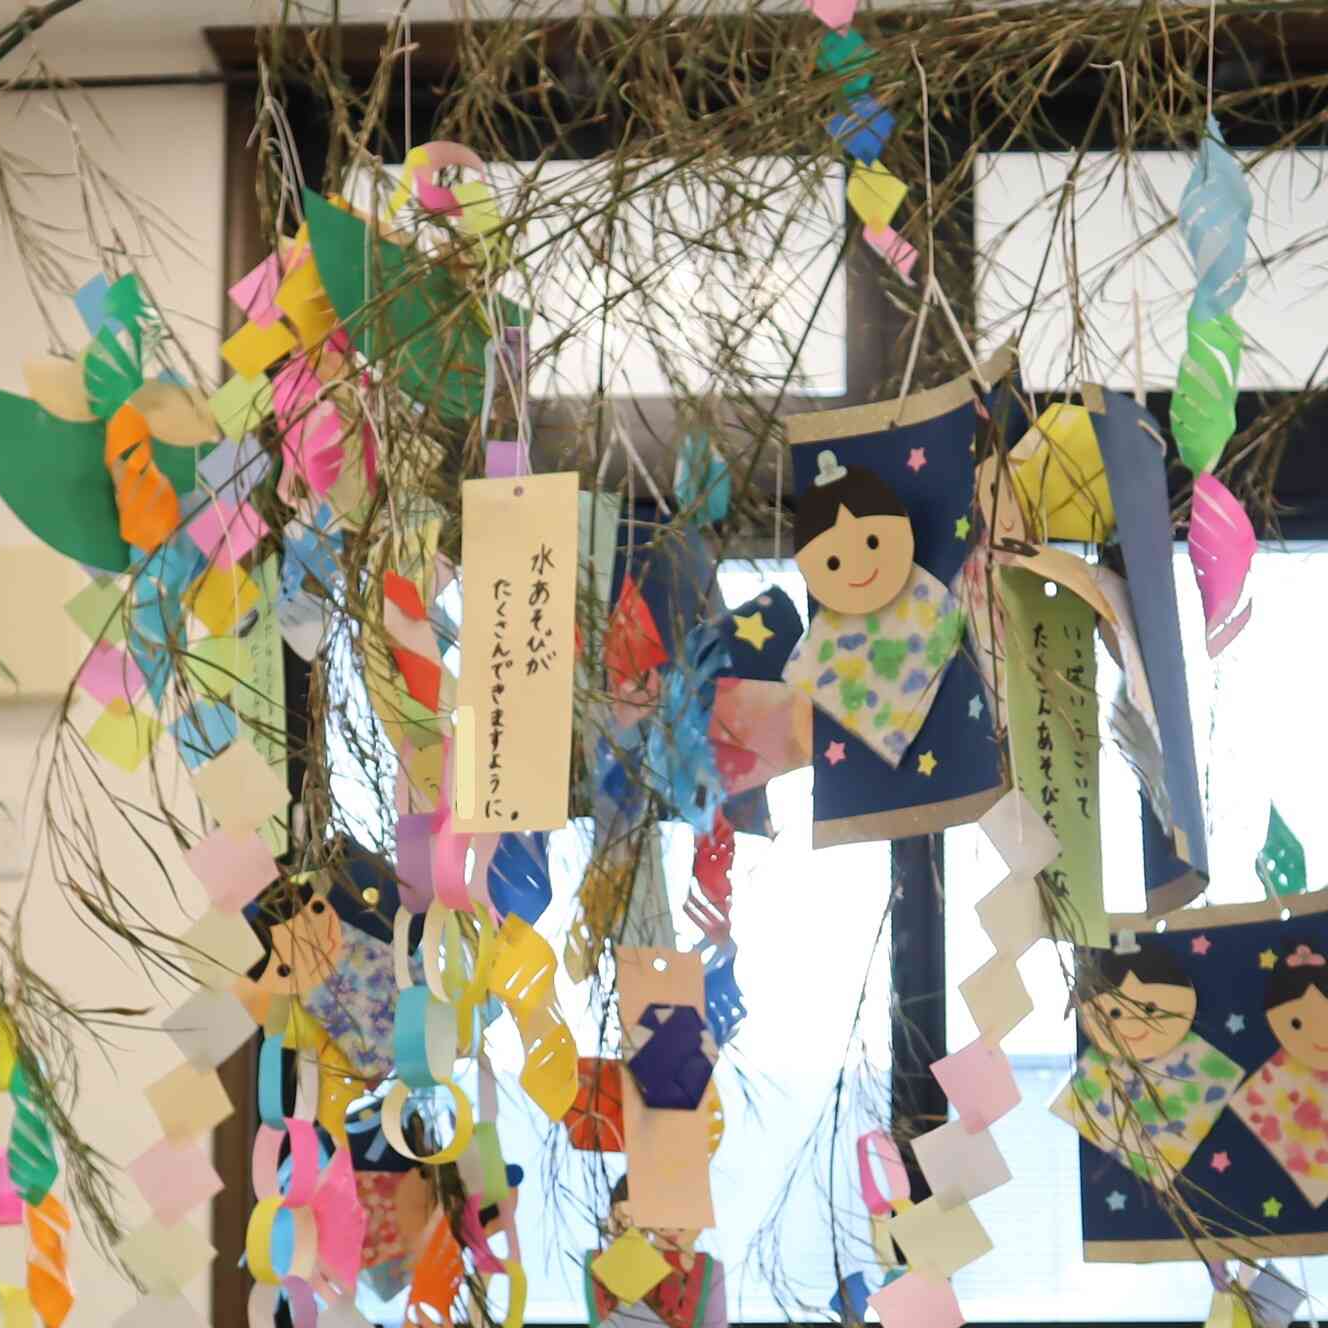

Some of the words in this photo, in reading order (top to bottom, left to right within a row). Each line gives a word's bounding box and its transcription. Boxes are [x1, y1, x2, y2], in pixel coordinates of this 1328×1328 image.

[524, 543, 557, 677] 水あそびが
